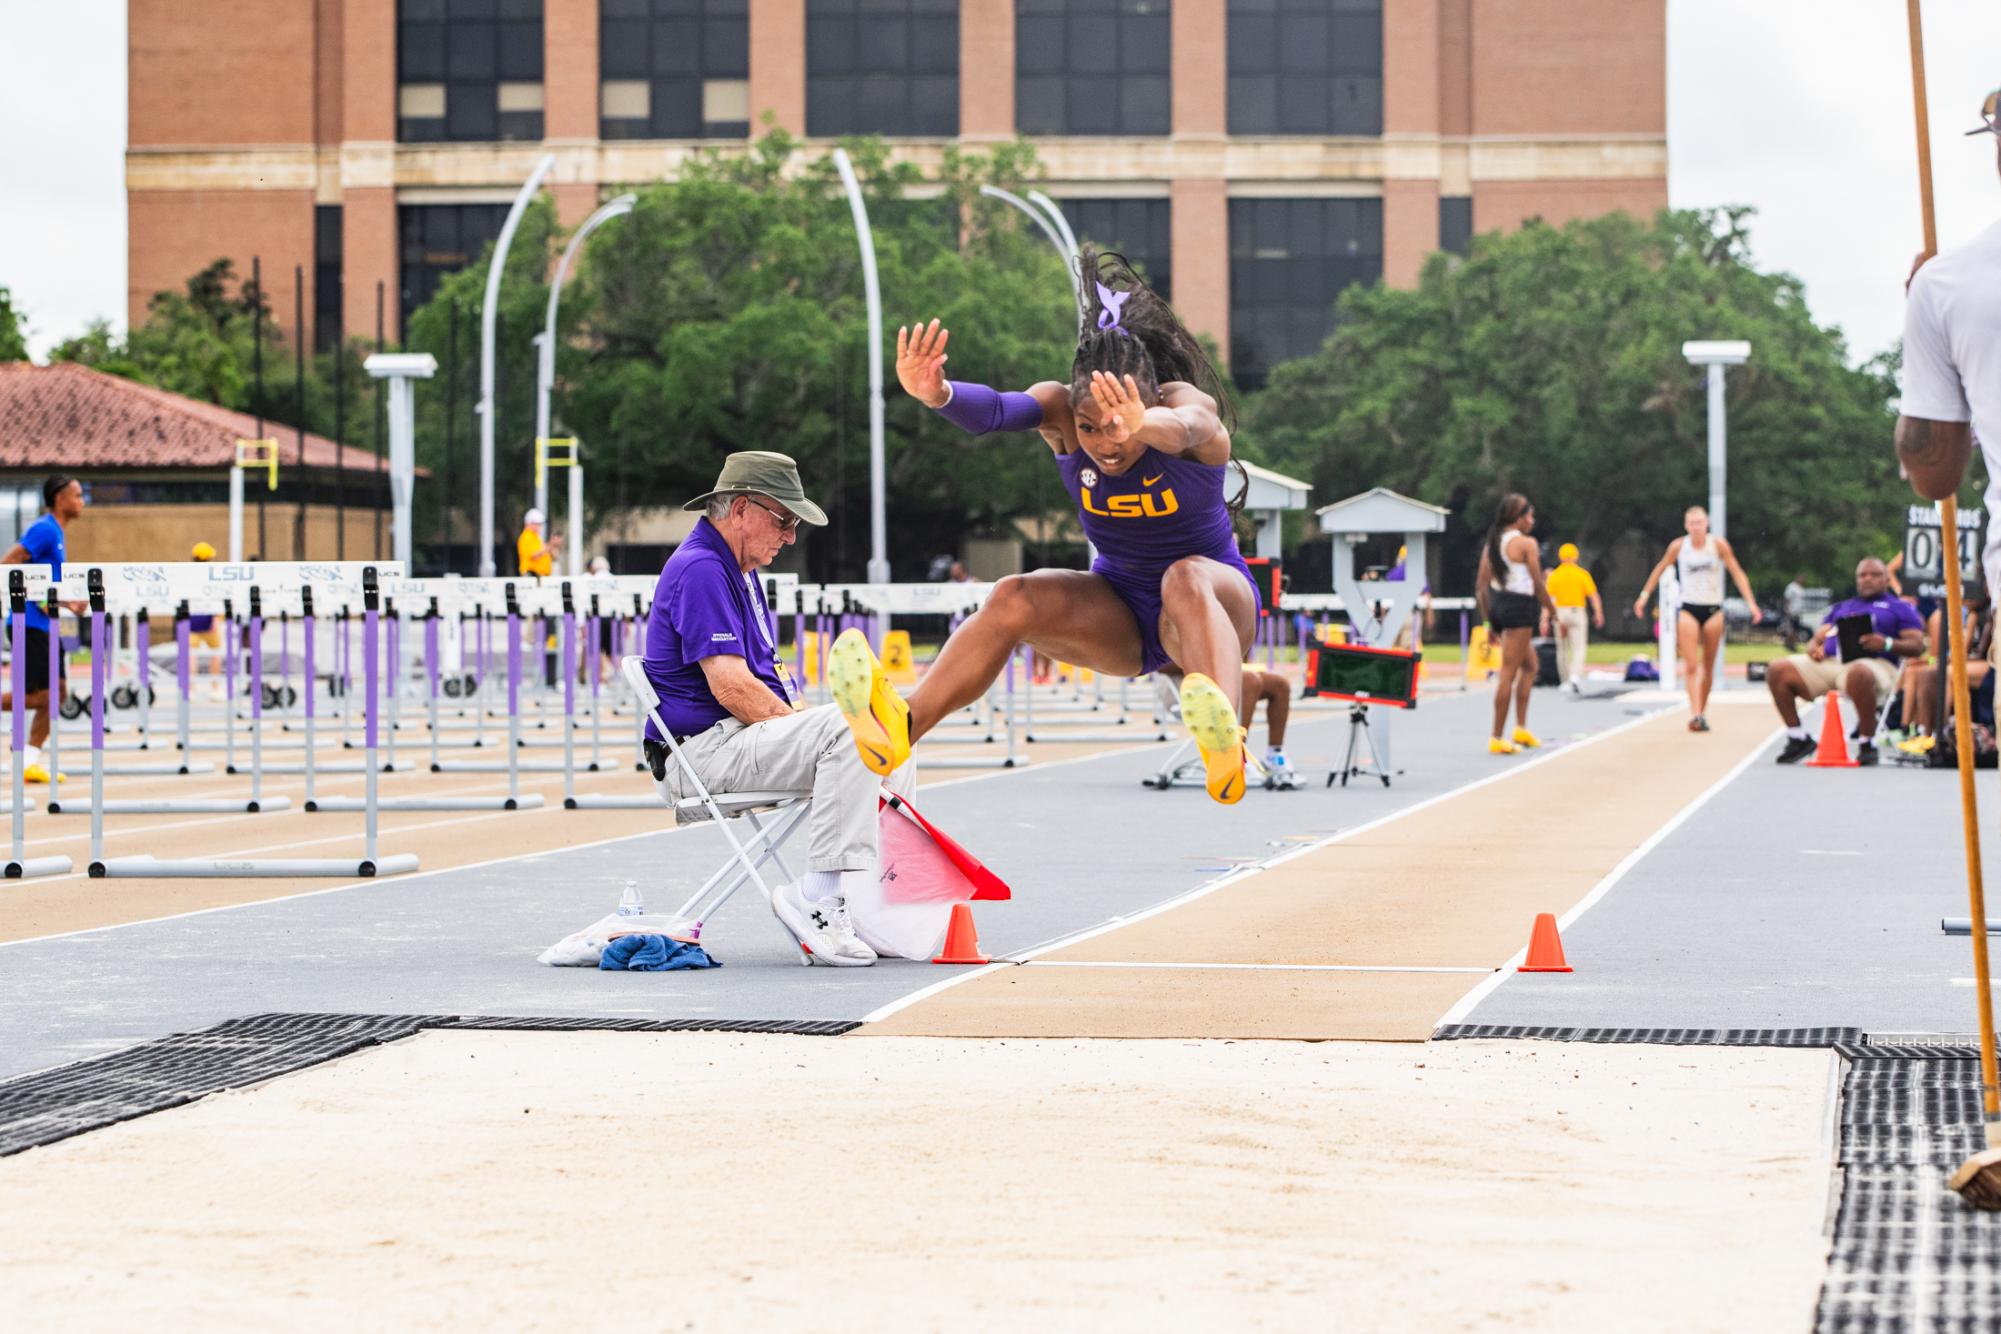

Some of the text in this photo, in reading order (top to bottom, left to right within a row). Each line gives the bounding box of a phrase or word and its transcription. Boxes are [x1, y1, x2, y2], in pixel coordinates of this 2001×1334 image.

[1081, 487, 1179, 517] LSU
[1908, 505, 1981, 528] STANRDS
[209, 566, 254, 580] LSU
